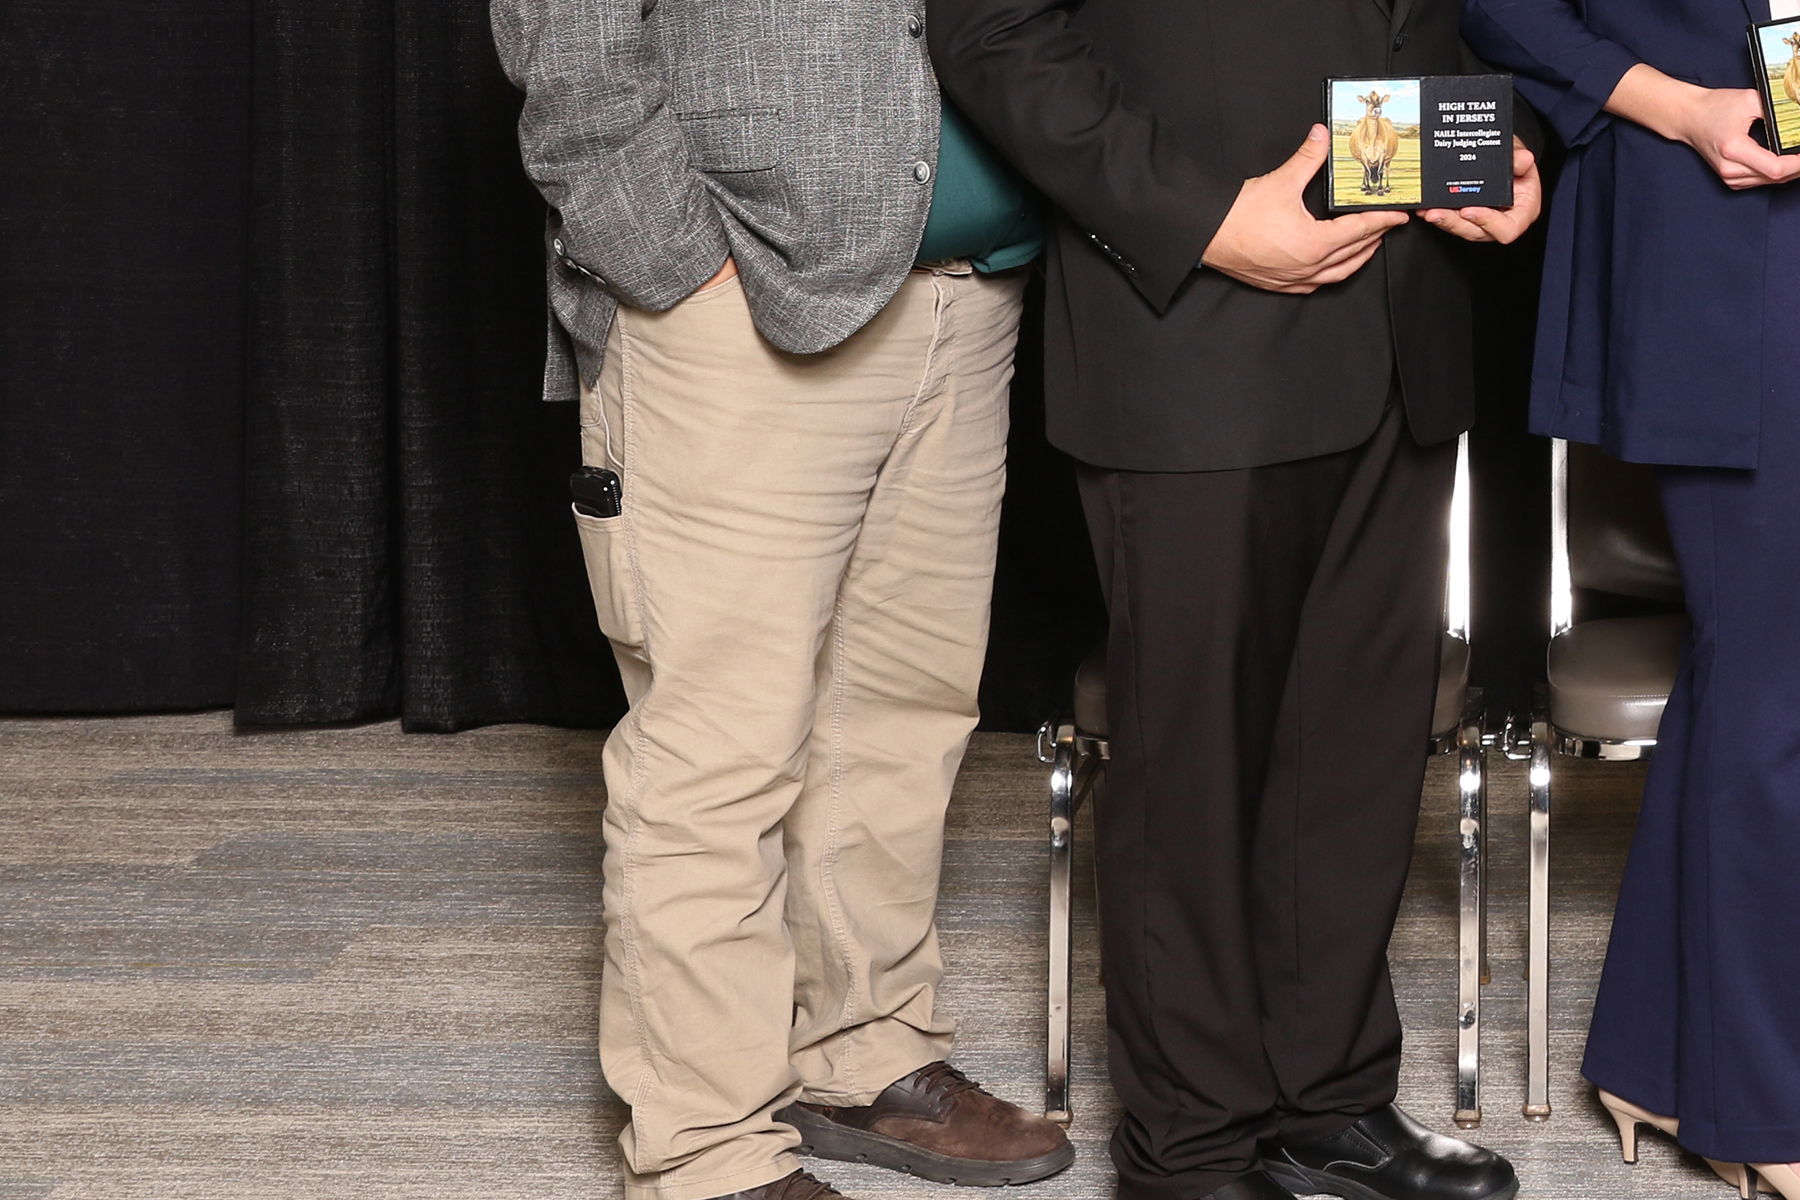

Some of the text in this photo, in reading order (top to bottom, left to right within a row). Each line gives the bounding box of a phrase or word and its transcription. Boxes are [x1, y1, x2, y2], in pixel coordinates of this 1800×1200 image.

[1438, 102, 1496, 111] HIGH TEAM
[1442, 114, 1495, 124] IN JERSEYS
[1457, 130, 1501, 138] Intercollegiate
[1434, 140, 1452, 148] Dairy
[1453, 139, 1476, 148] Judging
